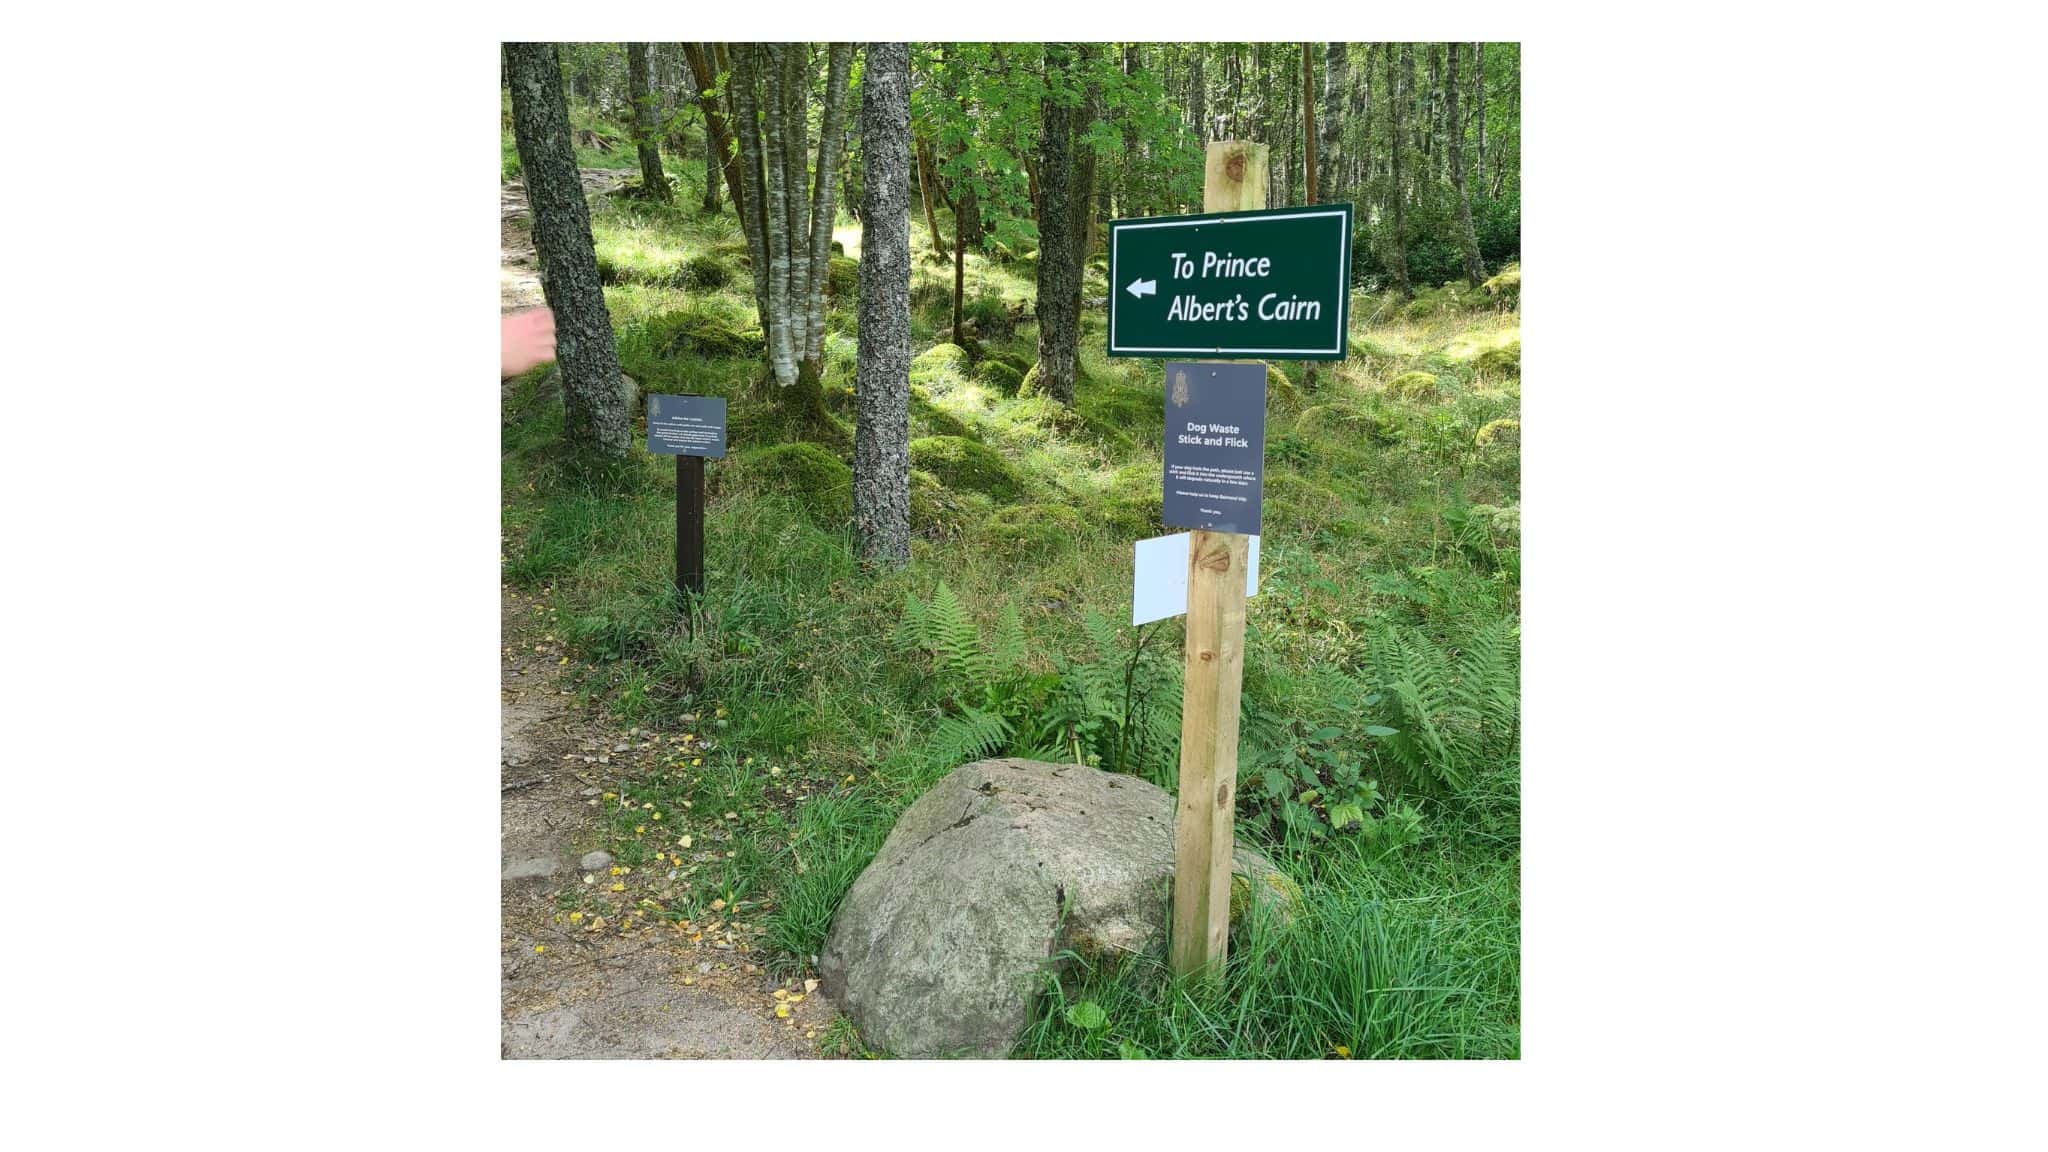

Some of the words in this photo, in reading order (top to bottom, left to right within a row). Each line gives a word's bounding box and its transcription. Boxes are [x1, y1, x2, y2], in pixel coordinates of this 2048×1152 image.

[1171, 252, 1194, 279] To
[1202, 251, 1271, 278] Prince
[1167, 294, 1249, 321] Albert’s
[1257, 293, 1321, 321] Cairn
[1187, 422, 1207, 434] Dog
[1209, 423, 1240, 434] Waste
[1178, 434, 1202, 445] Stick
[1204, 437, 1222, 446] and
[1225, 437, 1248, 448] Flick
